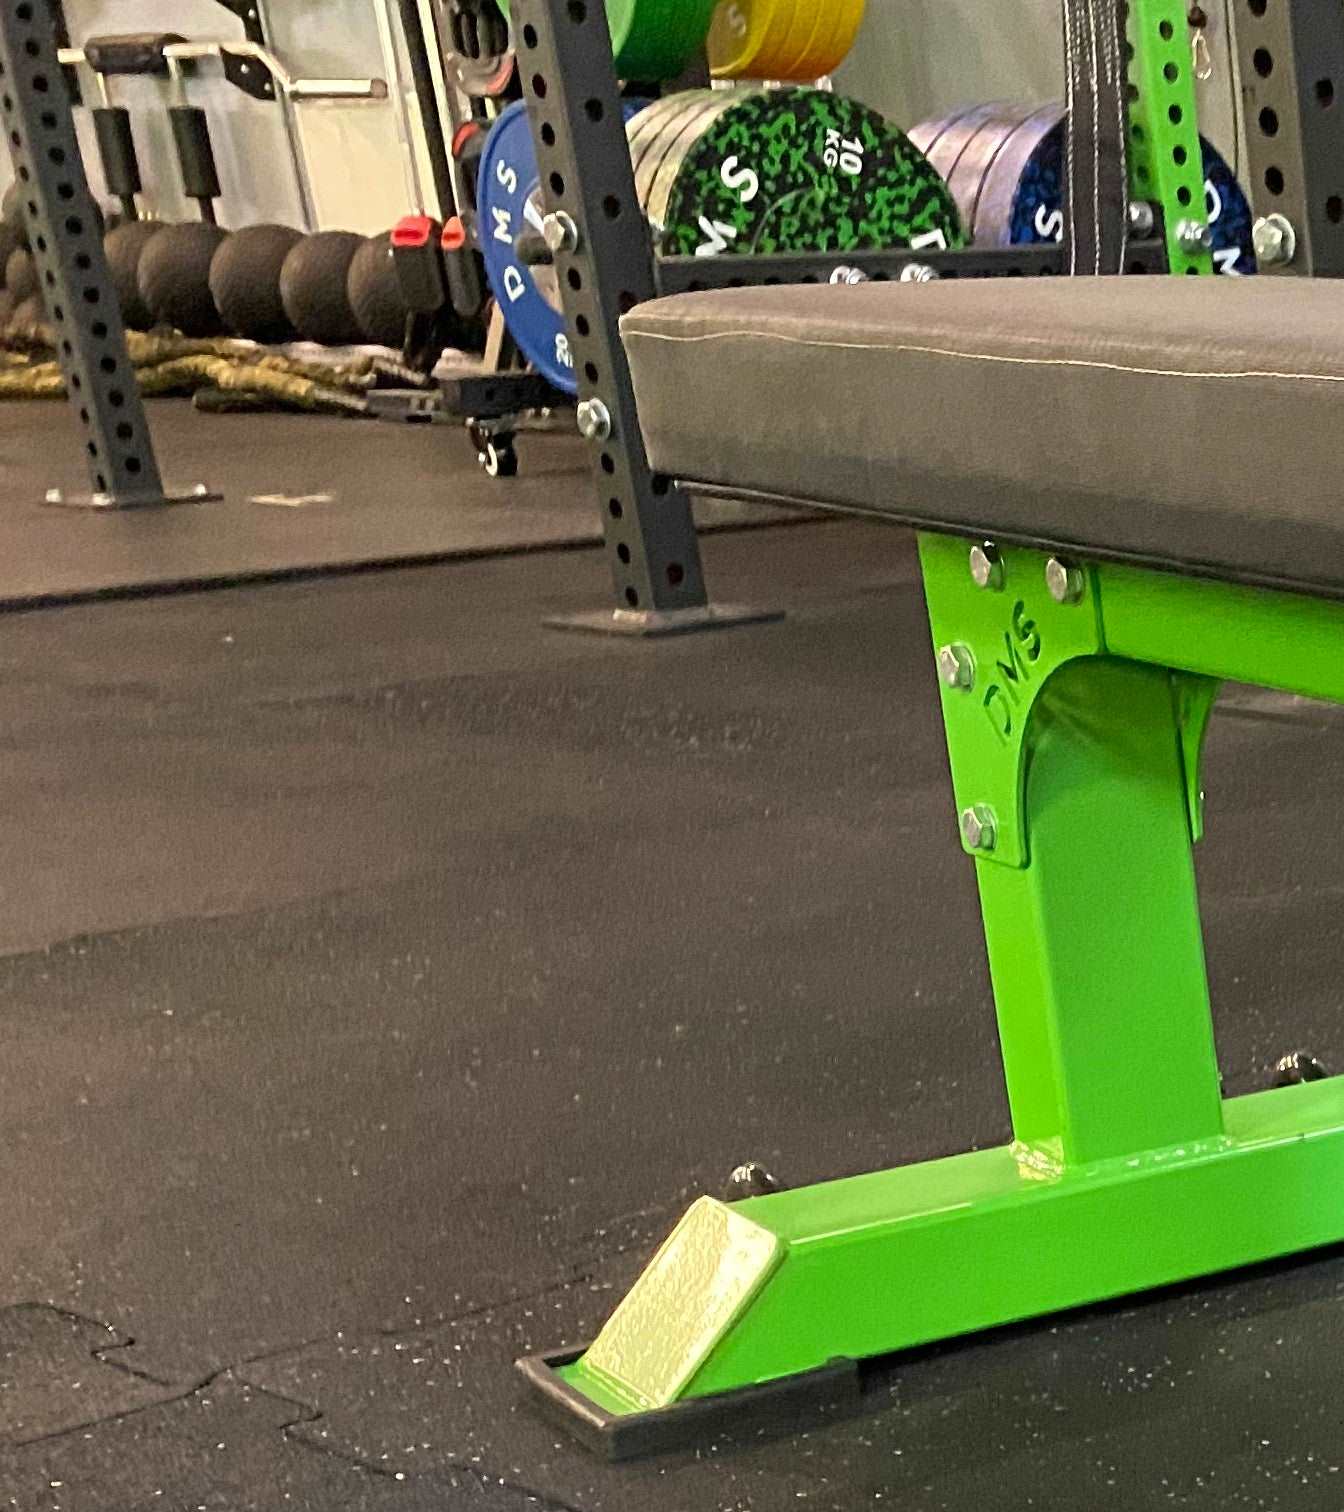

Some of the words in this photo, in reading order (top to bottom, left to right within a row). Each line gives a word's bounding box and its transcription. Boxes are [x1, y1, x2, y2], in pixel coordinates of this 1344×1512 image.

[823, 128, 841, 169] KG
[839, 136, 865, 176] 10
[492, 159, 525, 302] DMS
[695, 155, 759, 256] MS
[982, 600, 1041, 747] DMS
